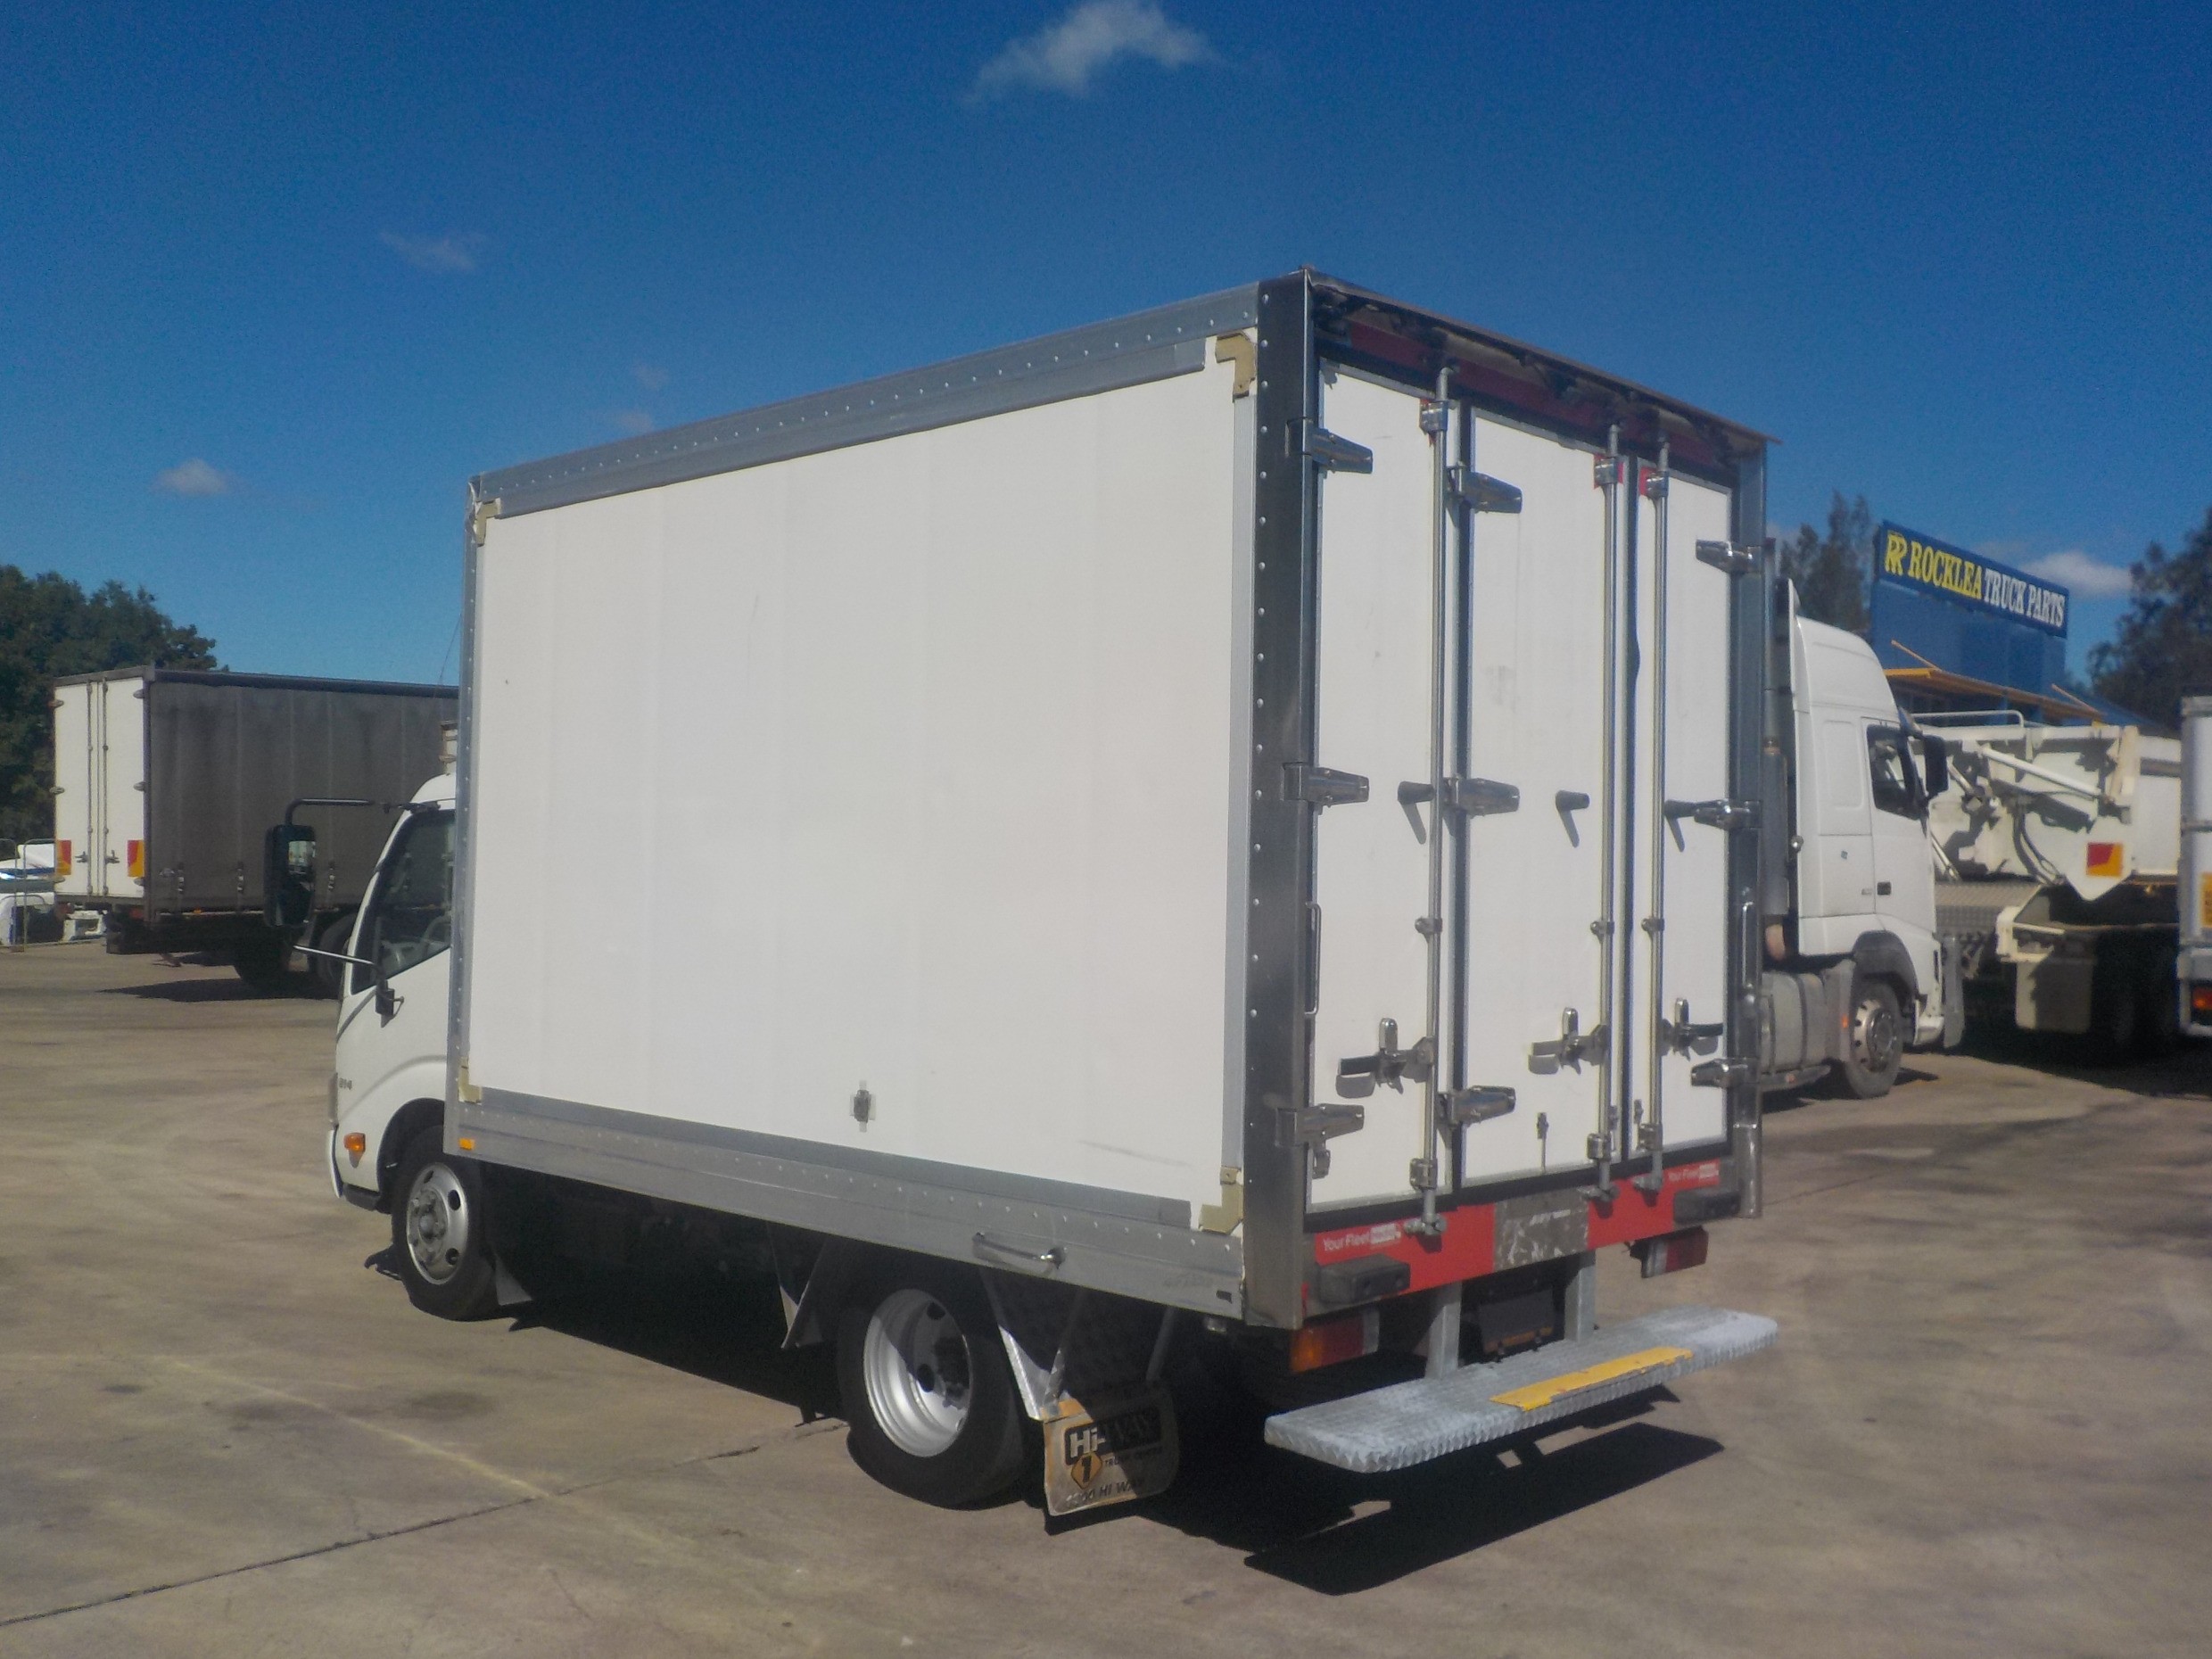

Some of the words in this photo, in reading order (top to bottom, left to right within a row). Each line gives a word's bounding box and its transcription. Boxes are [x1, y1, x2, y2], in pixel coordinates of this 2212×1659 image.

[1908, 541, 1982, 599] ROCKLEA
[1984, 568, 2026, 615] TRUCK
[2026, 584, 2066, 627] PARTS
[1323, 1237, 1343, 1251] Your
